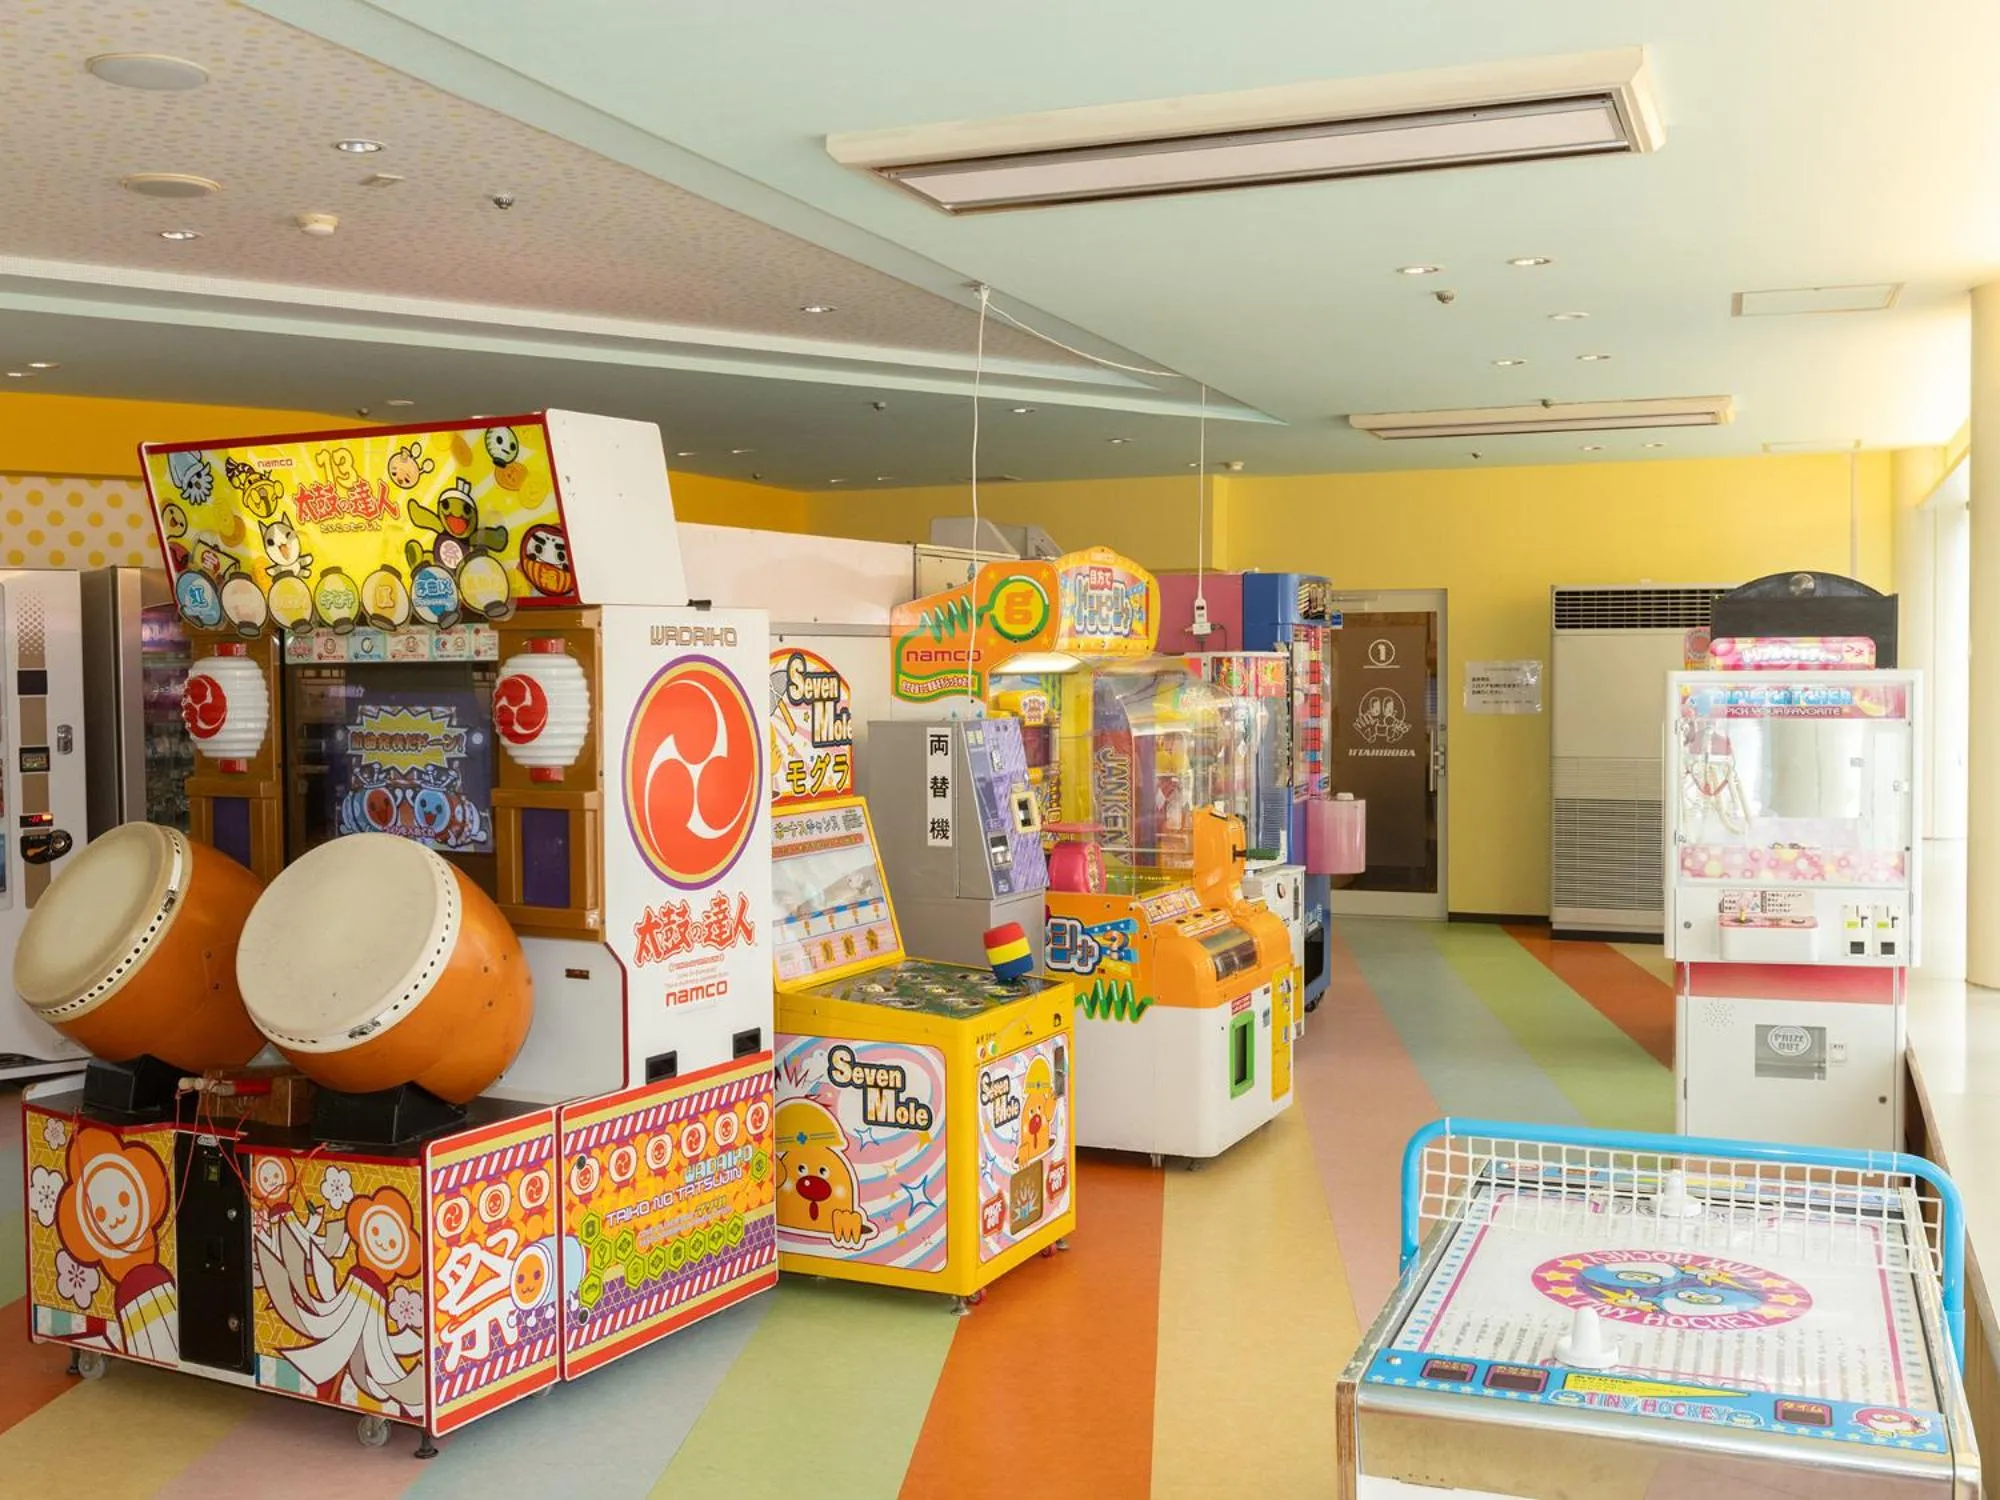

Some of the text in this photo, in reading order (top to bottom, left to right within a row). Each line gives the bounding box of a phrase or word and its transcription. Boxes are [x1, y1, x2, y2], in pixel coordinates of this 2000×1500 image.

[257, 458, 293, 468] namco
[315, 448, 354, 488] 13
[293, 479, 400, 524] 太鼓の達人
[906, 650, 981, 662] namco
[786, 653, 840, 705] Seven
[812, 700, 852, 748] Mole
[786, 752, 849, 795] モグラ
[929, 733, 951, 841] 両替機
[633, 892, 756, 967] 太鼓の達人
[665, 980, 728, 1008] namco
[828, 1045, 906, 1092] Seven
[981, 1072, 1010, 1106] Seven
[864, 1087, 932, 1130] Mole
[994, 1095, 1020, 1129] Mole
[606, 1199, 650, 1227] TAIKO
[652, 1189, 674, 1214] NO
[674, 1167, 743, 1201] TATSUJIN
[435, 1228, 519, 1372] 祭
[1643, 1311, 1765, 1330] HOCKEY
[1585, 1391, 1730, 1422] TINY HOCKEY
